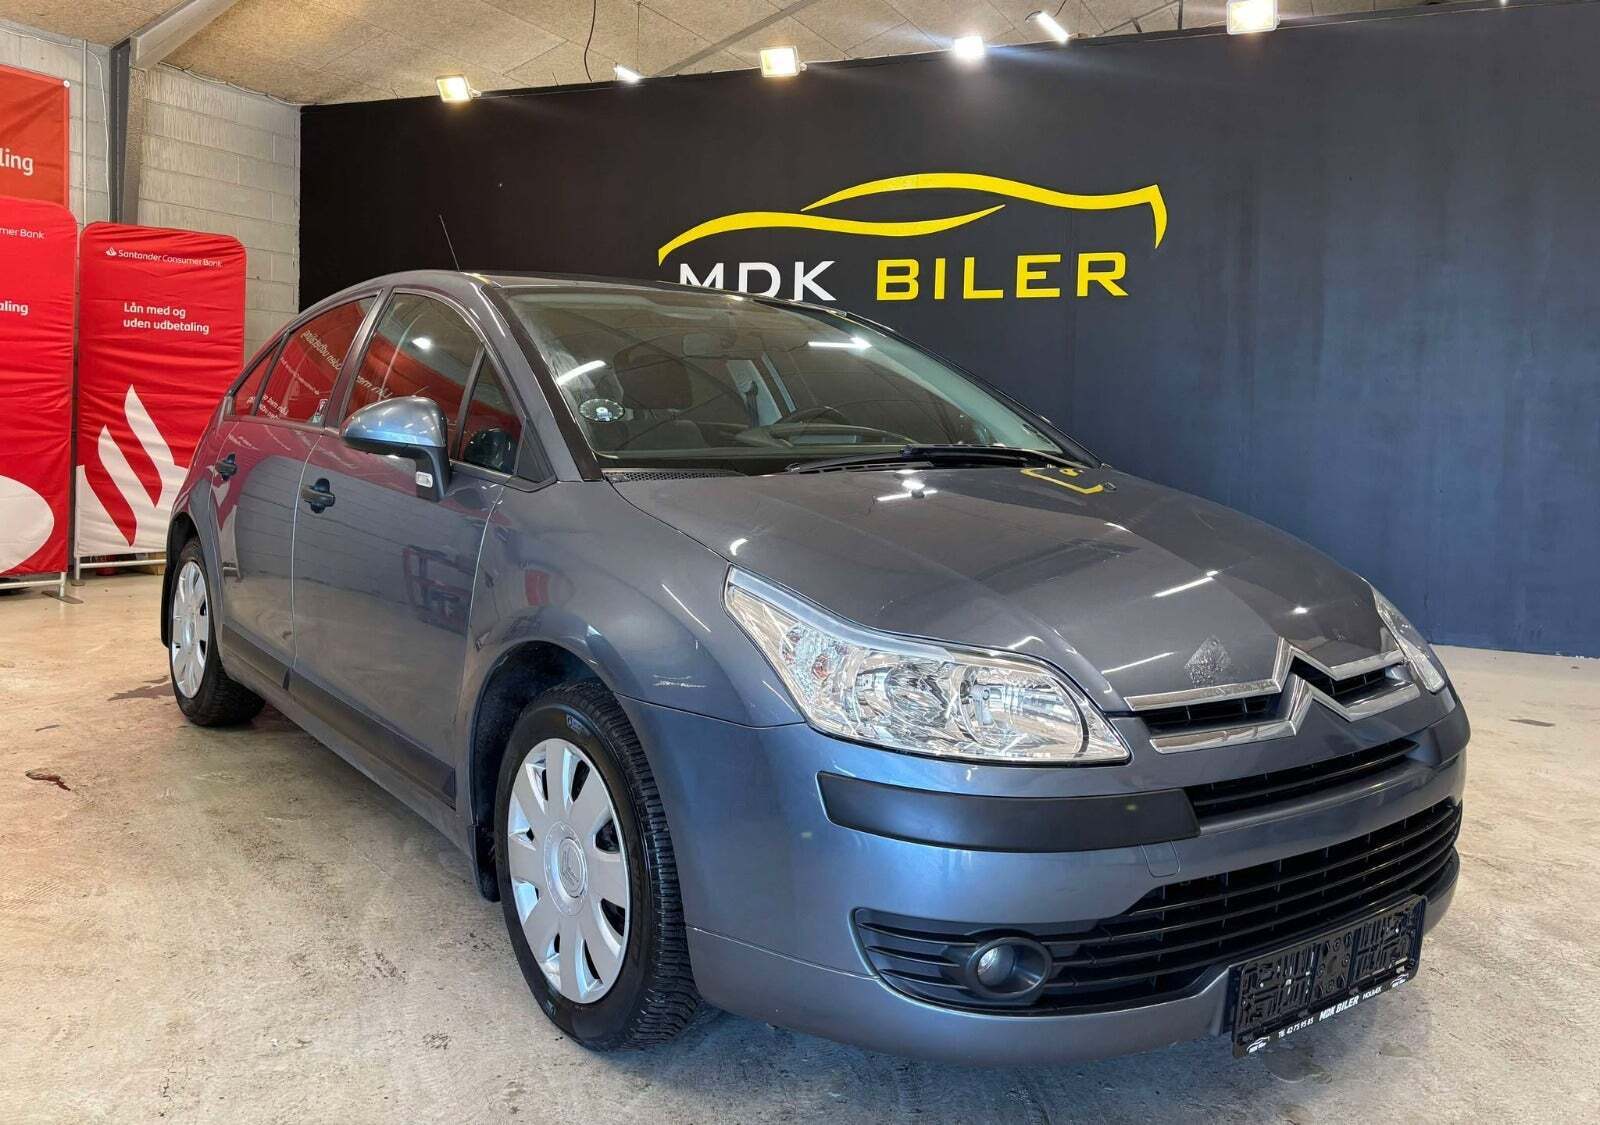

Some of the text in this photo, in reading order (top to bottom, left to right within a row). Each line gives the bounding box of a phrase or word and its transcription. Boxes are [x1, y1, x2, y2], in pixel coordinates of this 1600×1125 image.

[0, 147, 34, 176] ling
[20, 228, 45, 239] Bank
[118, 249, 223, 268] Santander Consumer Bank
[679, 252, 1129, 301] MDK BILER
[123, 301, 186, 319] Lån med og
[123, 317, 210, 335] uden udbetaling
[1335, 995, 1360, 1014] BILER
